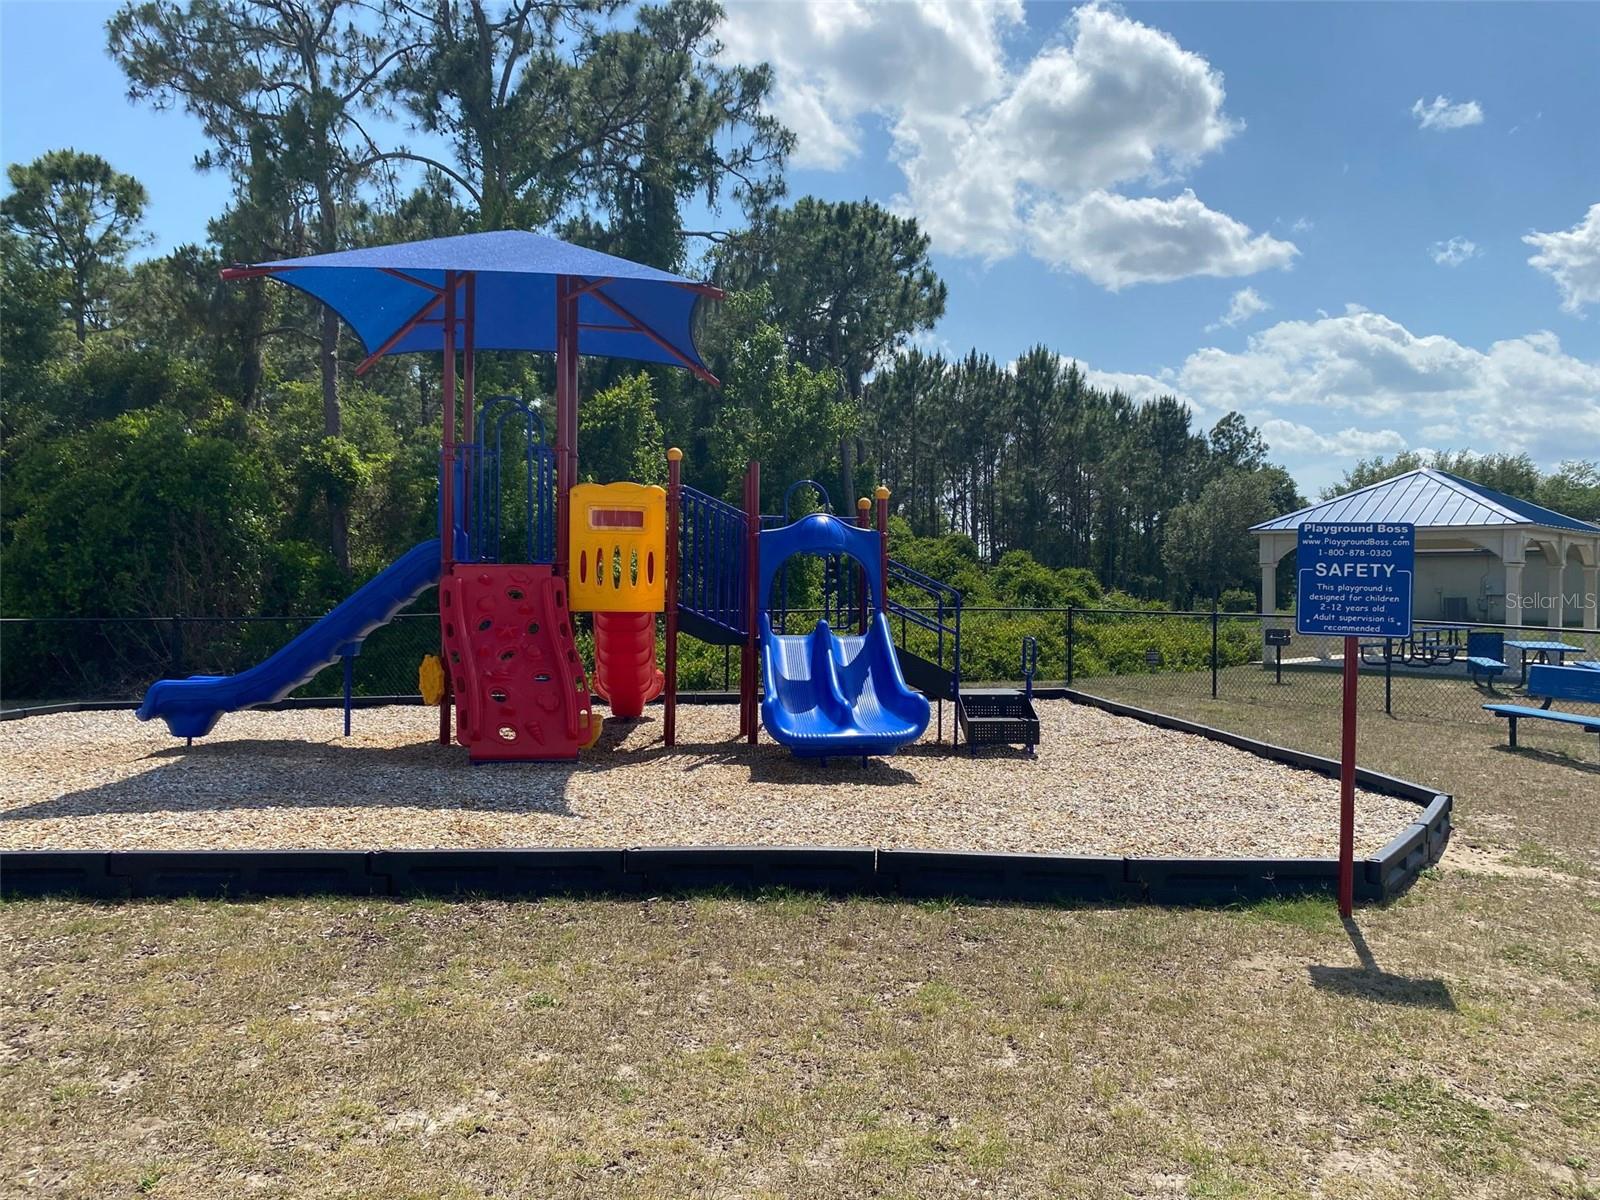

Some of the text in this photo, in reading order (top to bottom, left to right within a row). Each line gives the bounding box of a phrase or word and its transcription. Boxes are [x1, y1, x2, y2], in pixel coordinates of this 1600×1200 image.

[1304, 524, 1408, 534] Playground Boss
[1302, 538, 1410, 547] www.PlaygroundBoss.com
[1318, 549, 1392, 557] 1-800-878-0320
[1315, 563, 1395, 578] SAFETY
[1338, 584, 1383, 594] playground
[1309, 594, 1346, 602] designed
[1339, 614, 1384, 622] supervision
